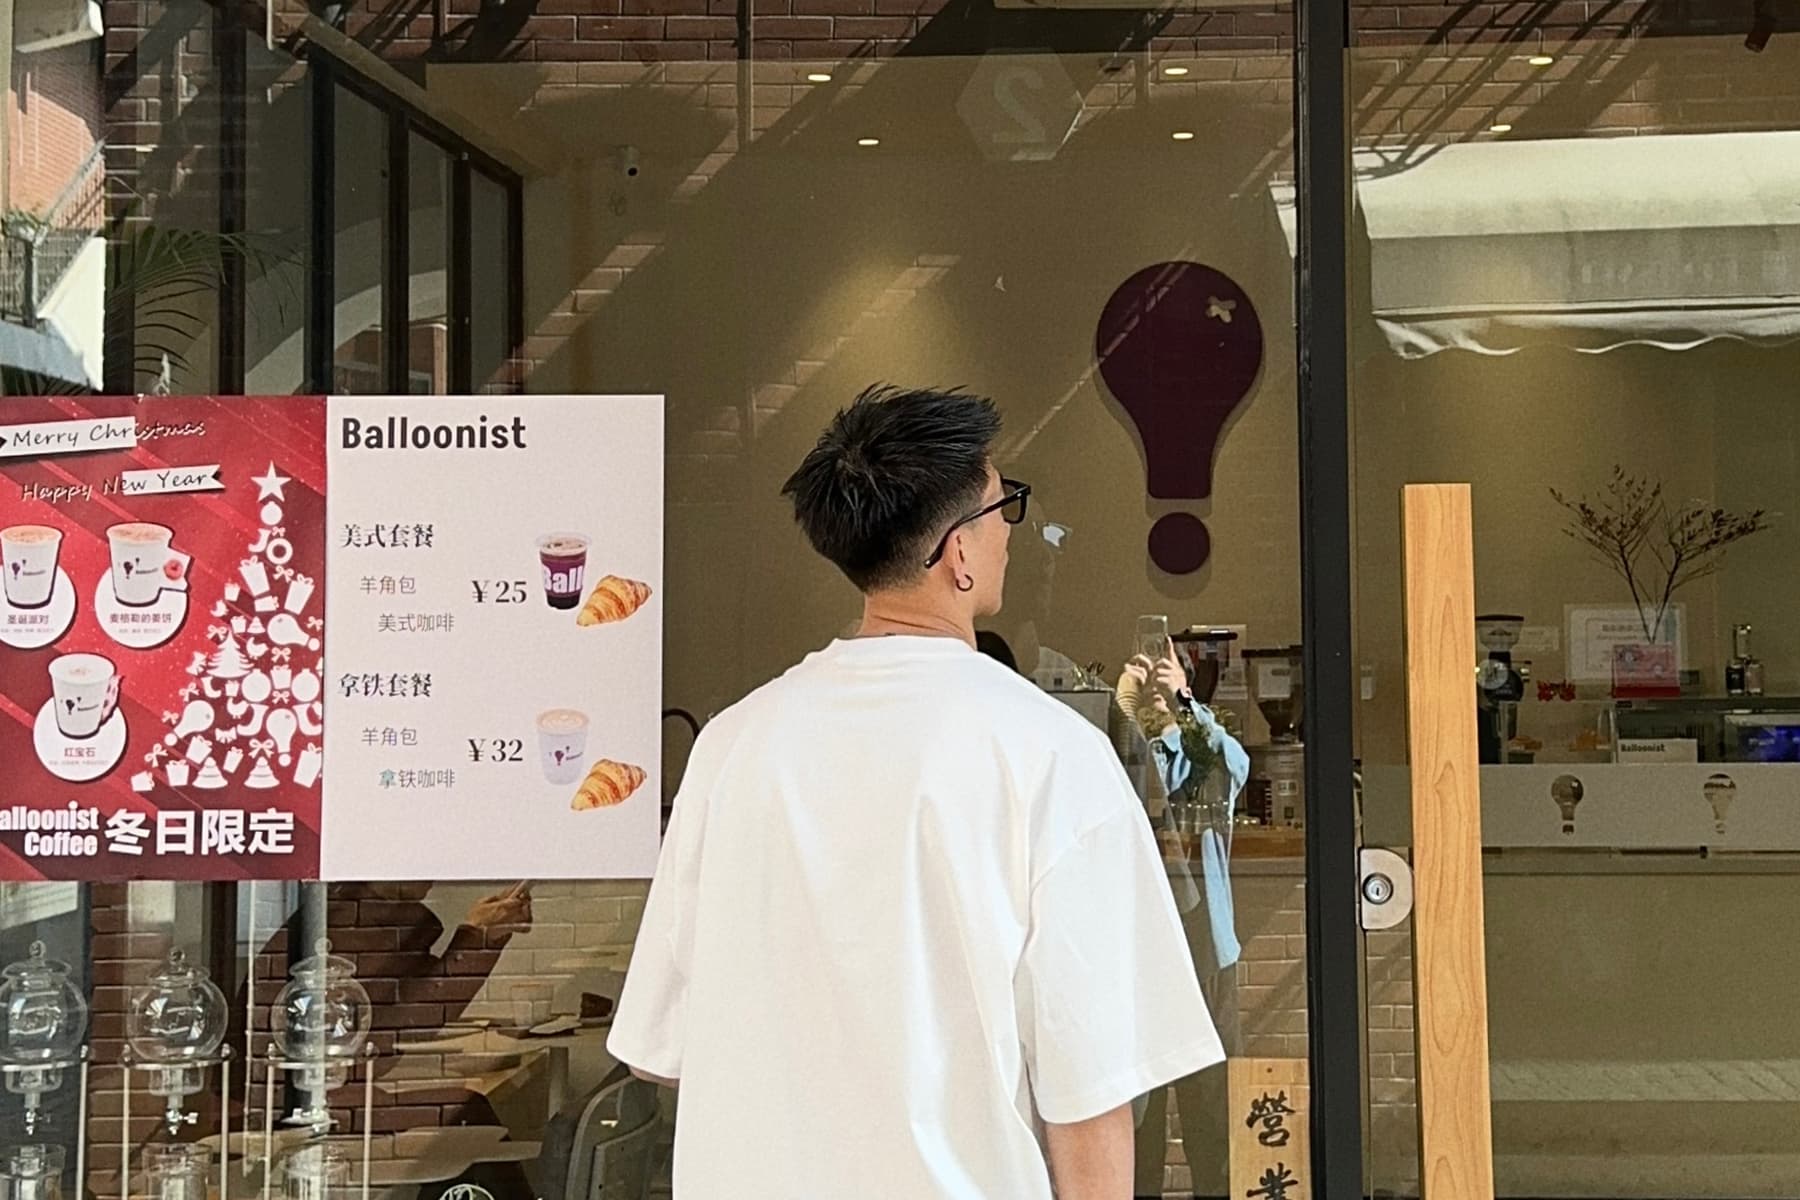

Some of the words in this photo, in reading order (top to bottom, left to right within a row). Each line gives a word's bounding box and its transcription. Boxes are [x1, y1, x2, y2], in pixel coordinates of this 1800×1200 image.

[13, 430, 79, 447] Merry
[90, 421, 206, 442] Christmas
[341, 415, 527, 449] Balloonist
[22, 483, 93, 503] Happy
[103, 475, 147, 496] New
[156, 471, 208, 489] Year
[341, 524, 434, 549] 美式套餐
[359, 576, 417, 595] 羊角包
[378, 613, 455, 632] 美式咖啡
[338, 673, 433, 697] 拿铁套餐
[361, 727, 418, 746] 羊角包
[64, 746, 96, 757] 红宝石
[378, 769, 456, 789] 拿铁咖啡
[105, 807, 295, 855] 冬日限定
[24, 831, 98, 857] Coffee
